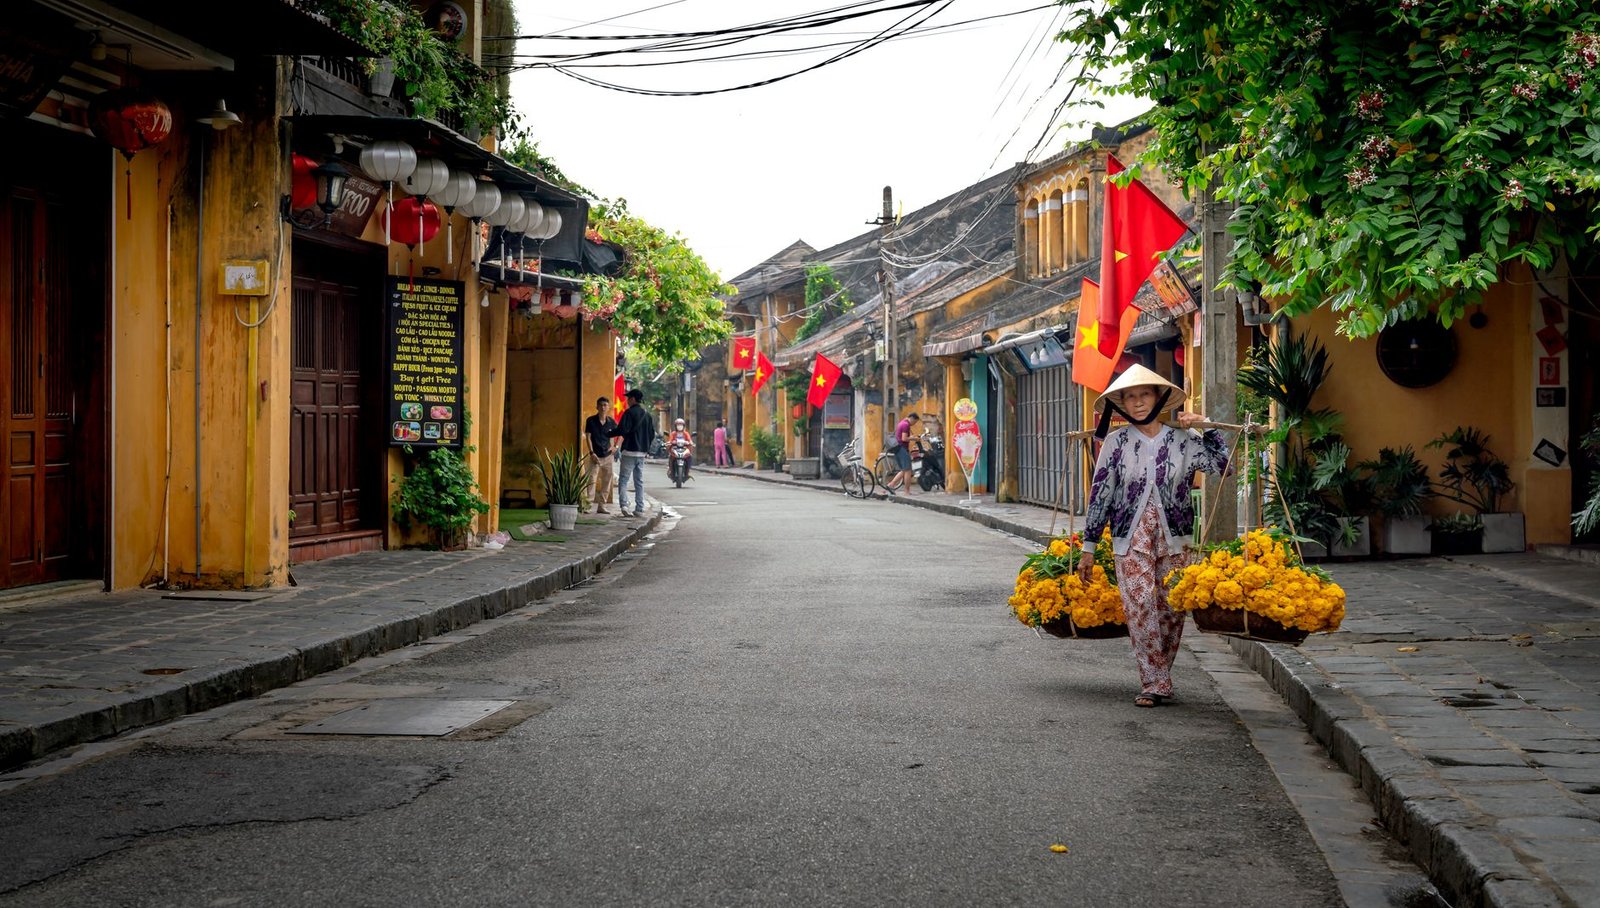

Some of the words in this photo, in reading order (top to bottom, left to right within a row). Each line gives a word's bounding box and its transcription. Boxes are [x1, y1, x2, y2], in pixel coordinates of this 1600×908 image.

[424, 285, 437, 293] LUNCH
[440, 286, 455, 295] DINNER
[402, 302, 415, 310] FRESH
[416, 303, 428, 311] FRUIT
[442, 305, 456, 313] CREAM
[422, 338, 440, 346] CHICKEN
[441, 339, 451, 347] RICE
[434, 348, 453, 356] PANCAKE
[393, 363, 408, 371] HAPPY
[408, 364, 420, 372] HOUR
[400, 374, 414, 383] Buy
[394, 384, 412, 392] MOJITO
[439, 386, 457, 394] MOJITO
